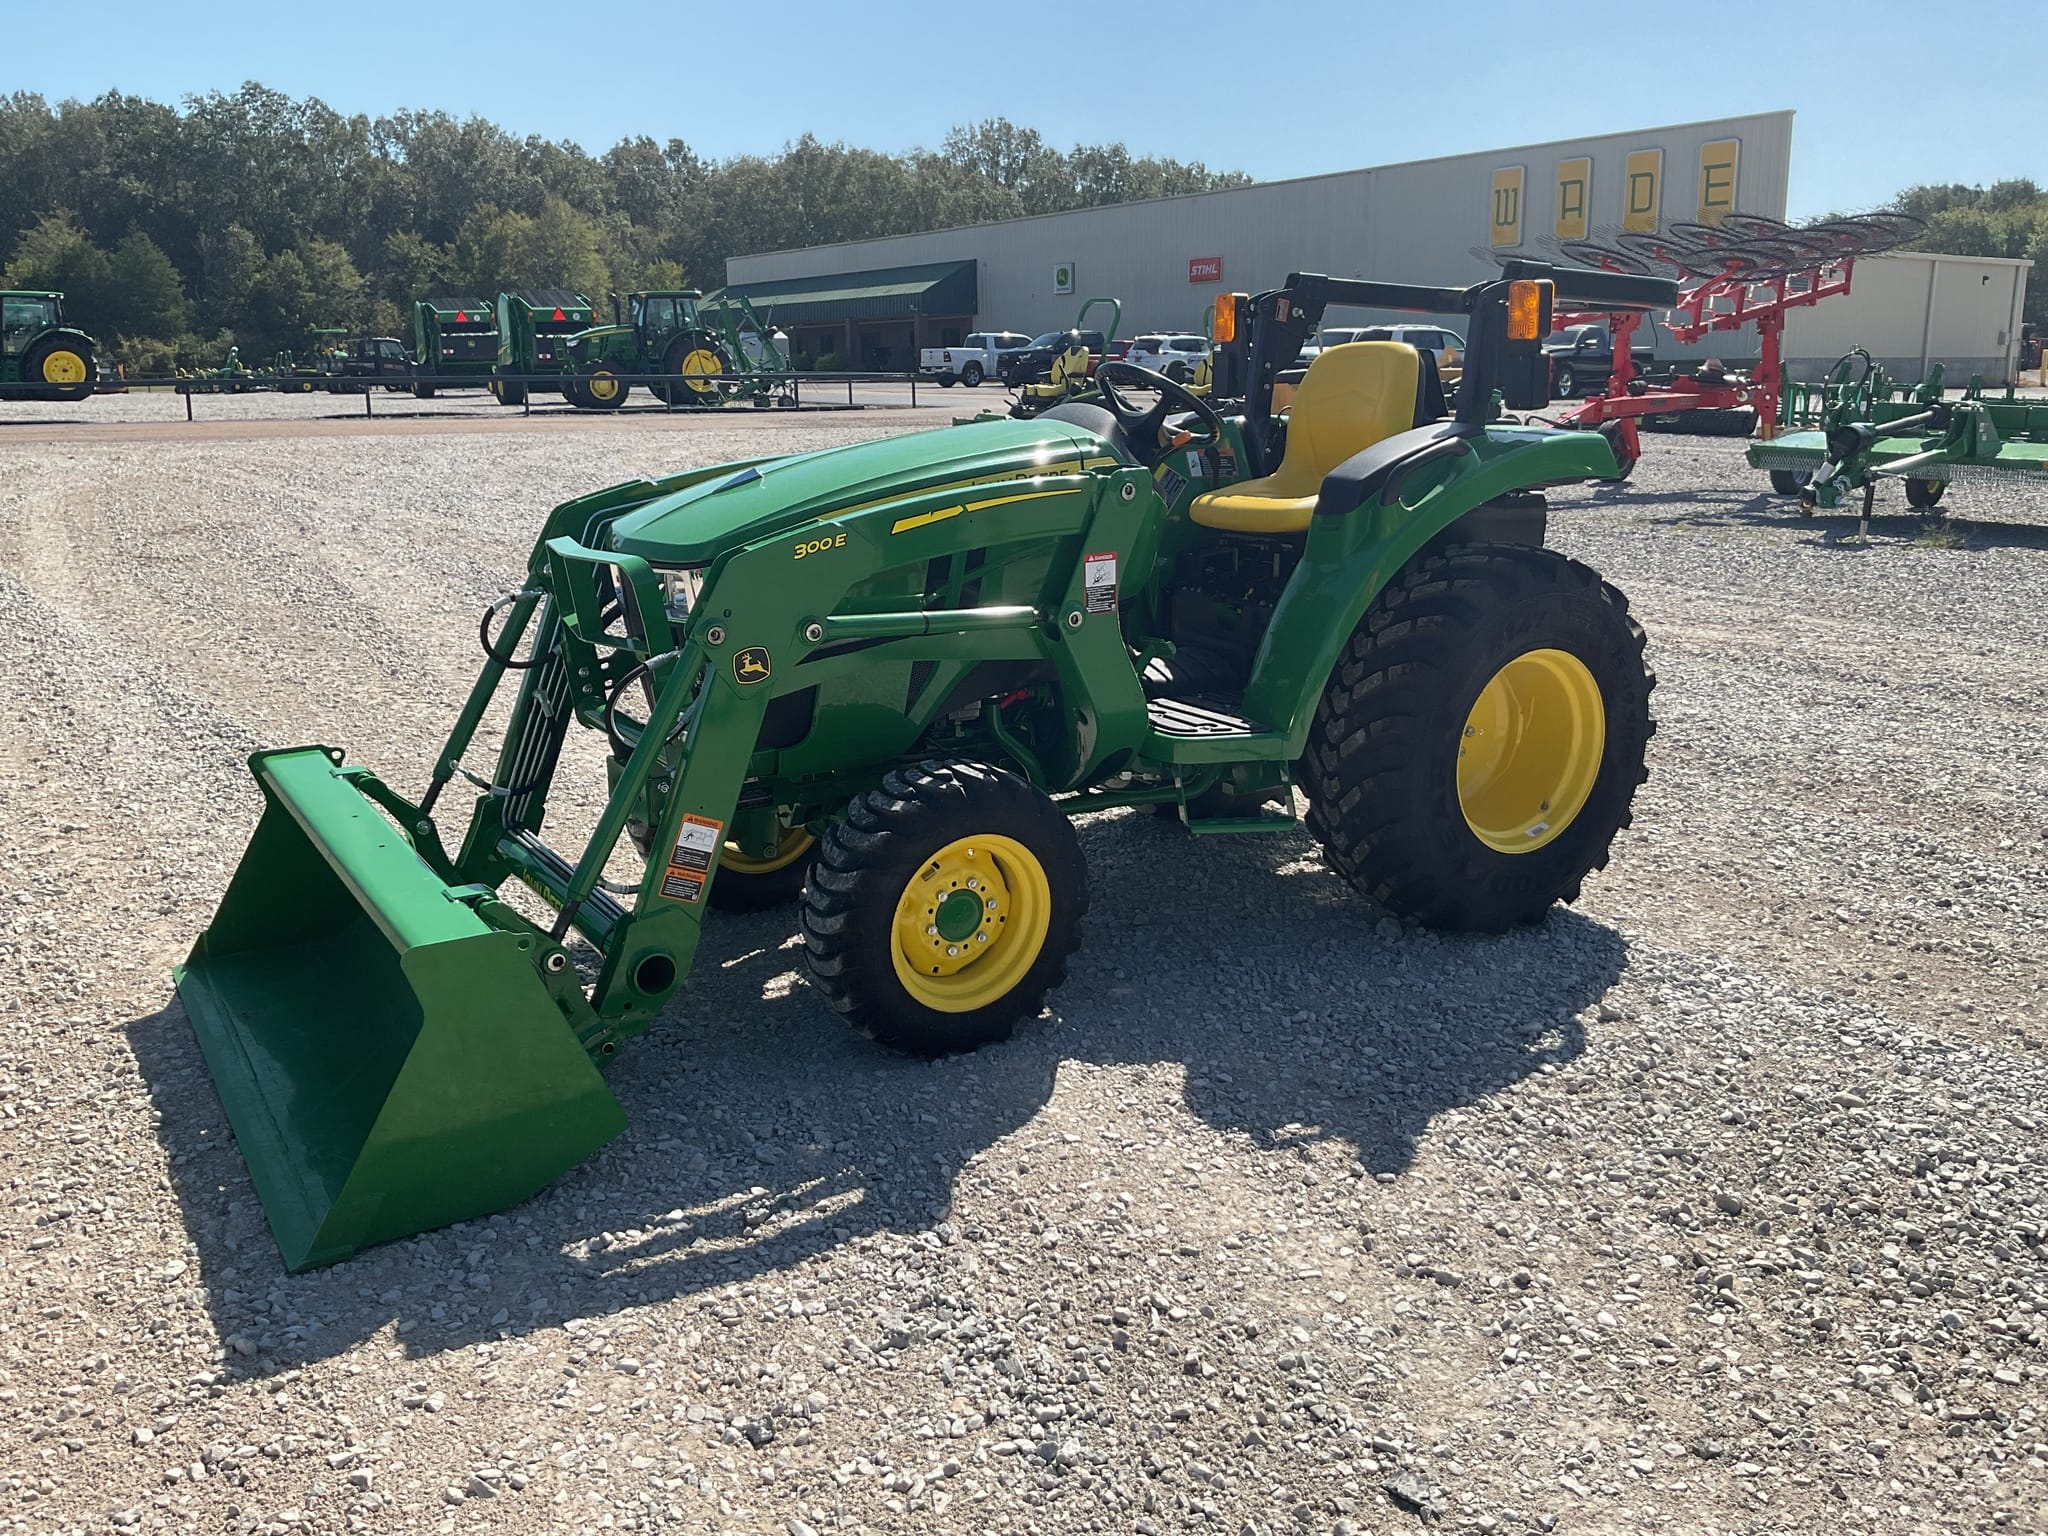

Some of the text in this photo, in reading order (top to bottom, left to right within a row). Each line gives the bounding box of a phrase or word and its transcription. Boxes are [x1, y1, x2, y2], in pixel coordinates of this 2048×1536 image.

[1494, 162, 1732, 227] WADE
[1190, 264, 1218, 276] STIHL
[693, 816, 719, 828] WARNING
